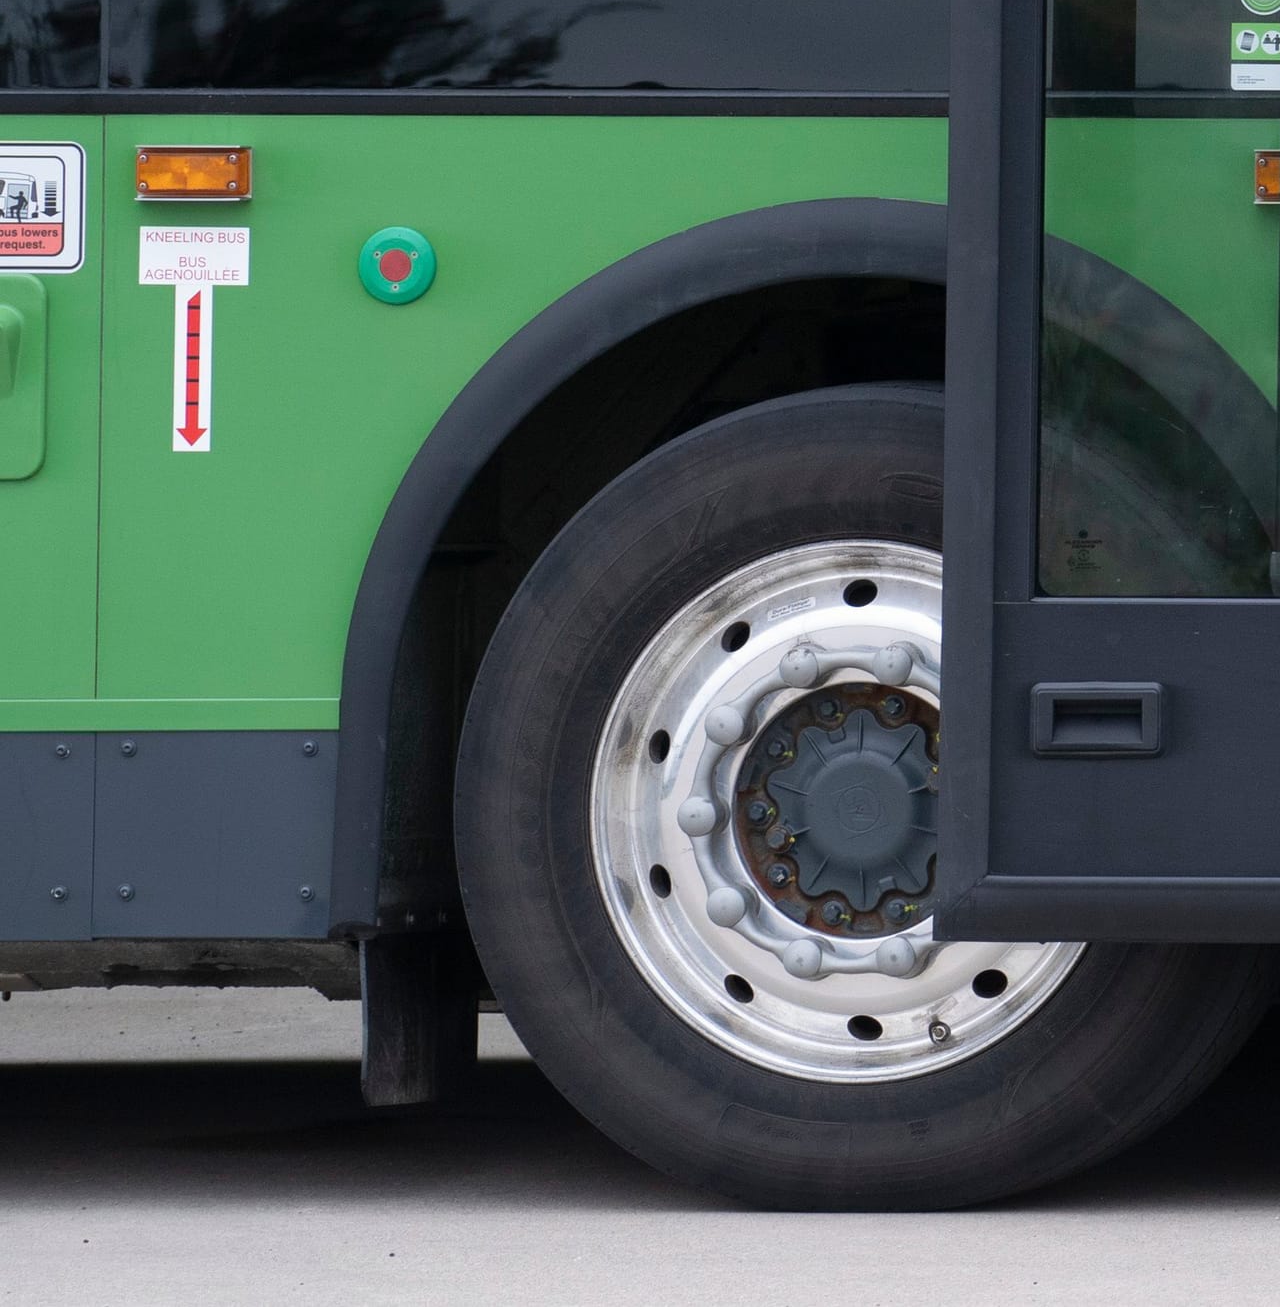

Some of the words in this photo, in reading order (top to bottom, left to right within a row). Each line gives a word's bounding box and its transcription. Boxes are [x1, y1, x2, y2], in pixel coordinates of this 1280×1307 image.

[21, 228, 58, 237] lowers
[146, 232, 214, 243] KNEELING
[218, 232, 246, 244] BUS
[0, 241, 45, 250] request.
[179, 257, 206, 267] BUS
[145, 268, 240, 280] AGENOUILLÉE
